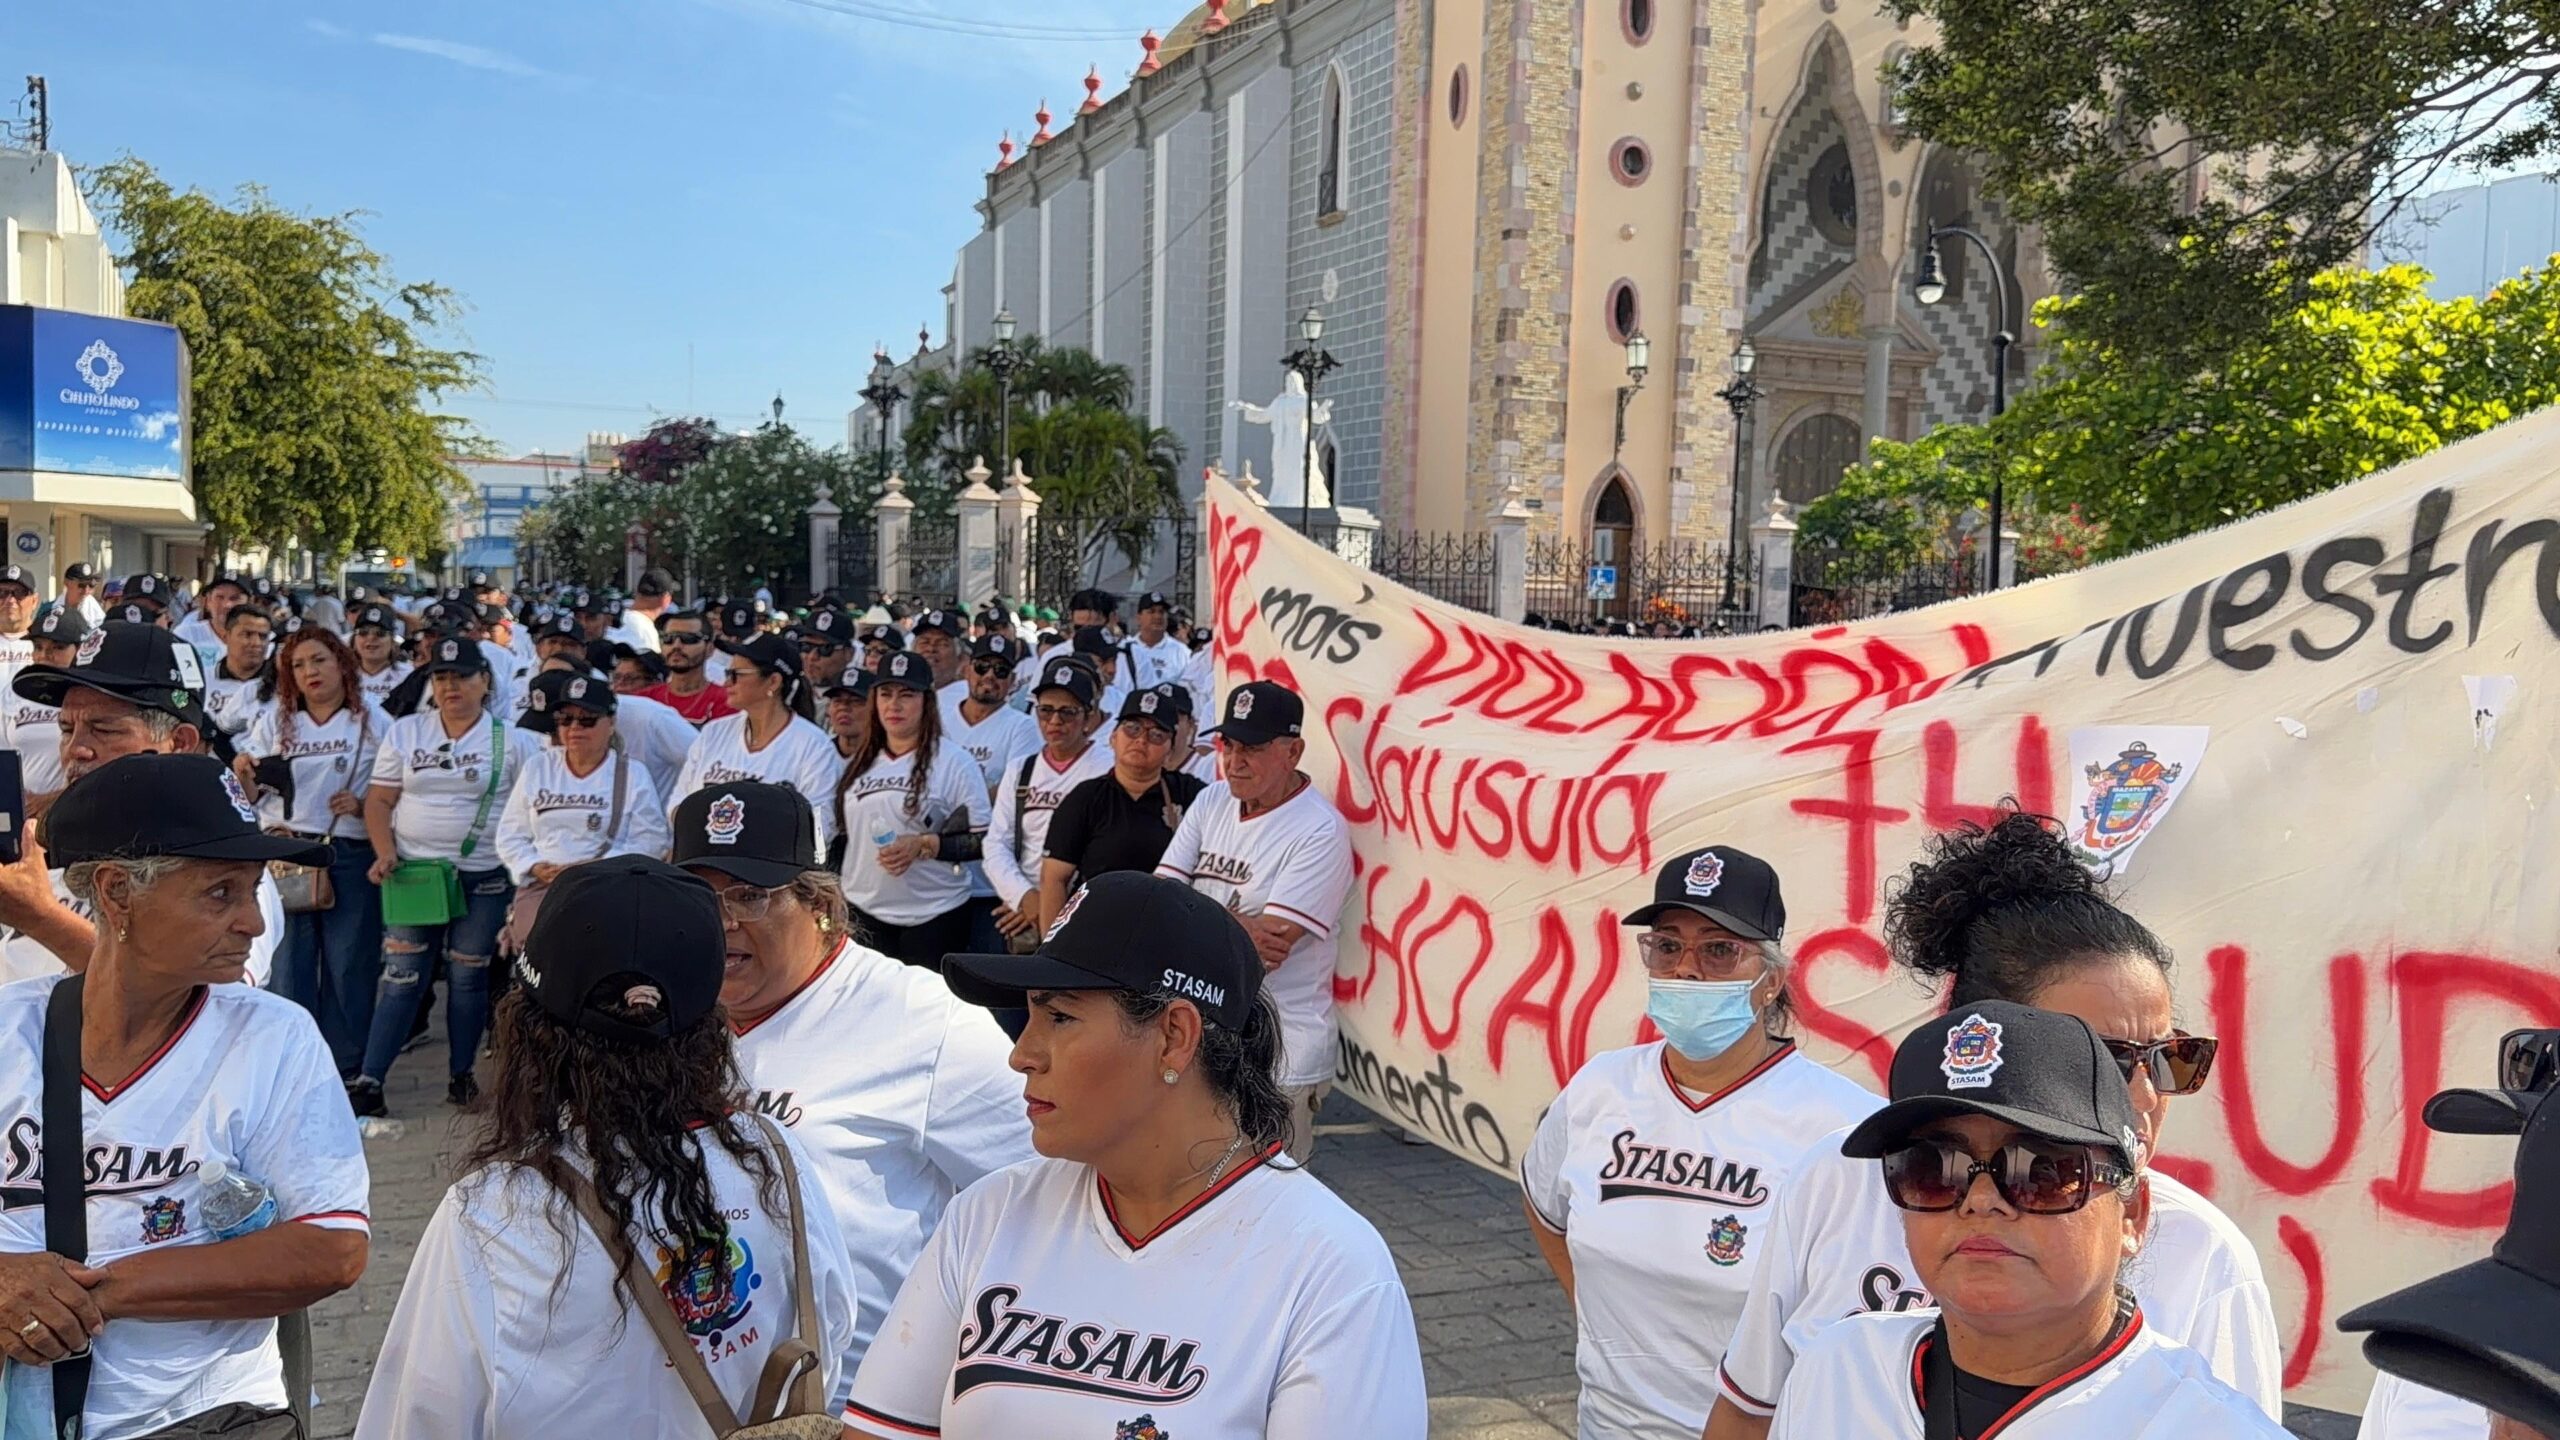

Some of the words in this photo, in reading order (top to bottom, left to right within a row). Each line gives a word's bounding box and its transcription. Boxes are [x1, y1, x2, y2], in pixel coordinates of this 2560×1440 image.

[1161, 967, 1226, 1007] STASAM
[1950, 1075, 1986, 1085] STASAM
[1599, 1129, 1769, 1207] STASAM
[956, 1284, 1207, 1400] STASAM
